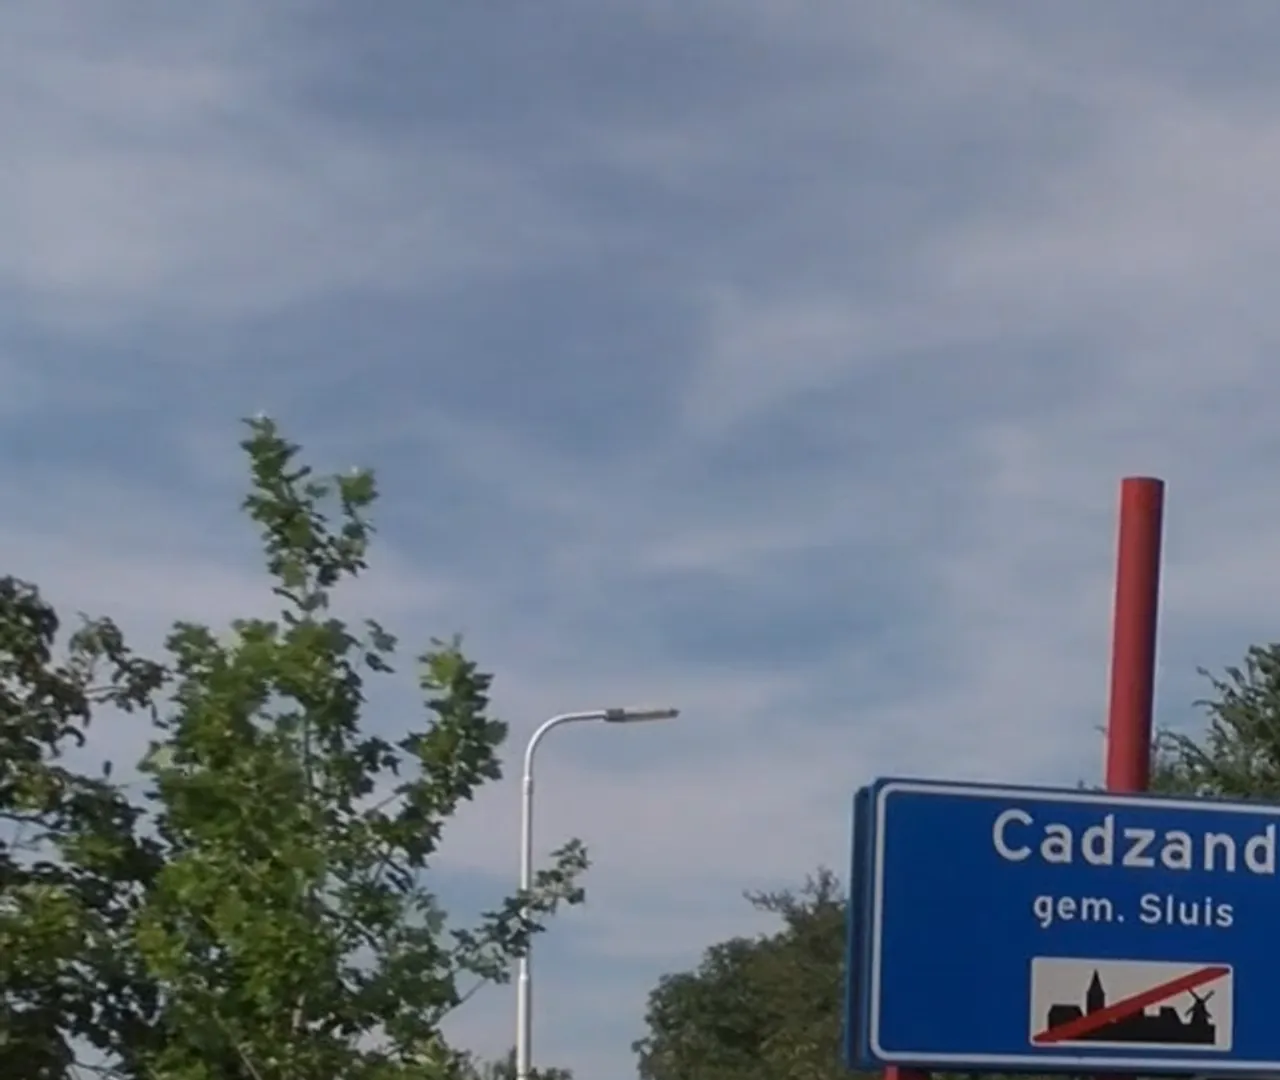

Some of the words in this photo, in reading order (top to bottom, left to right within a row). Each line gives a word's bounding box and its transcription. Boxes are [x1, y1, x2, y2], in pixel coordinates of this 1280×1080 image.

[992, 808, 1277, 875] Cadzand
[1033, 895, 1125, 928] gem.
[1139, 893, 1234, 928] Sluis
